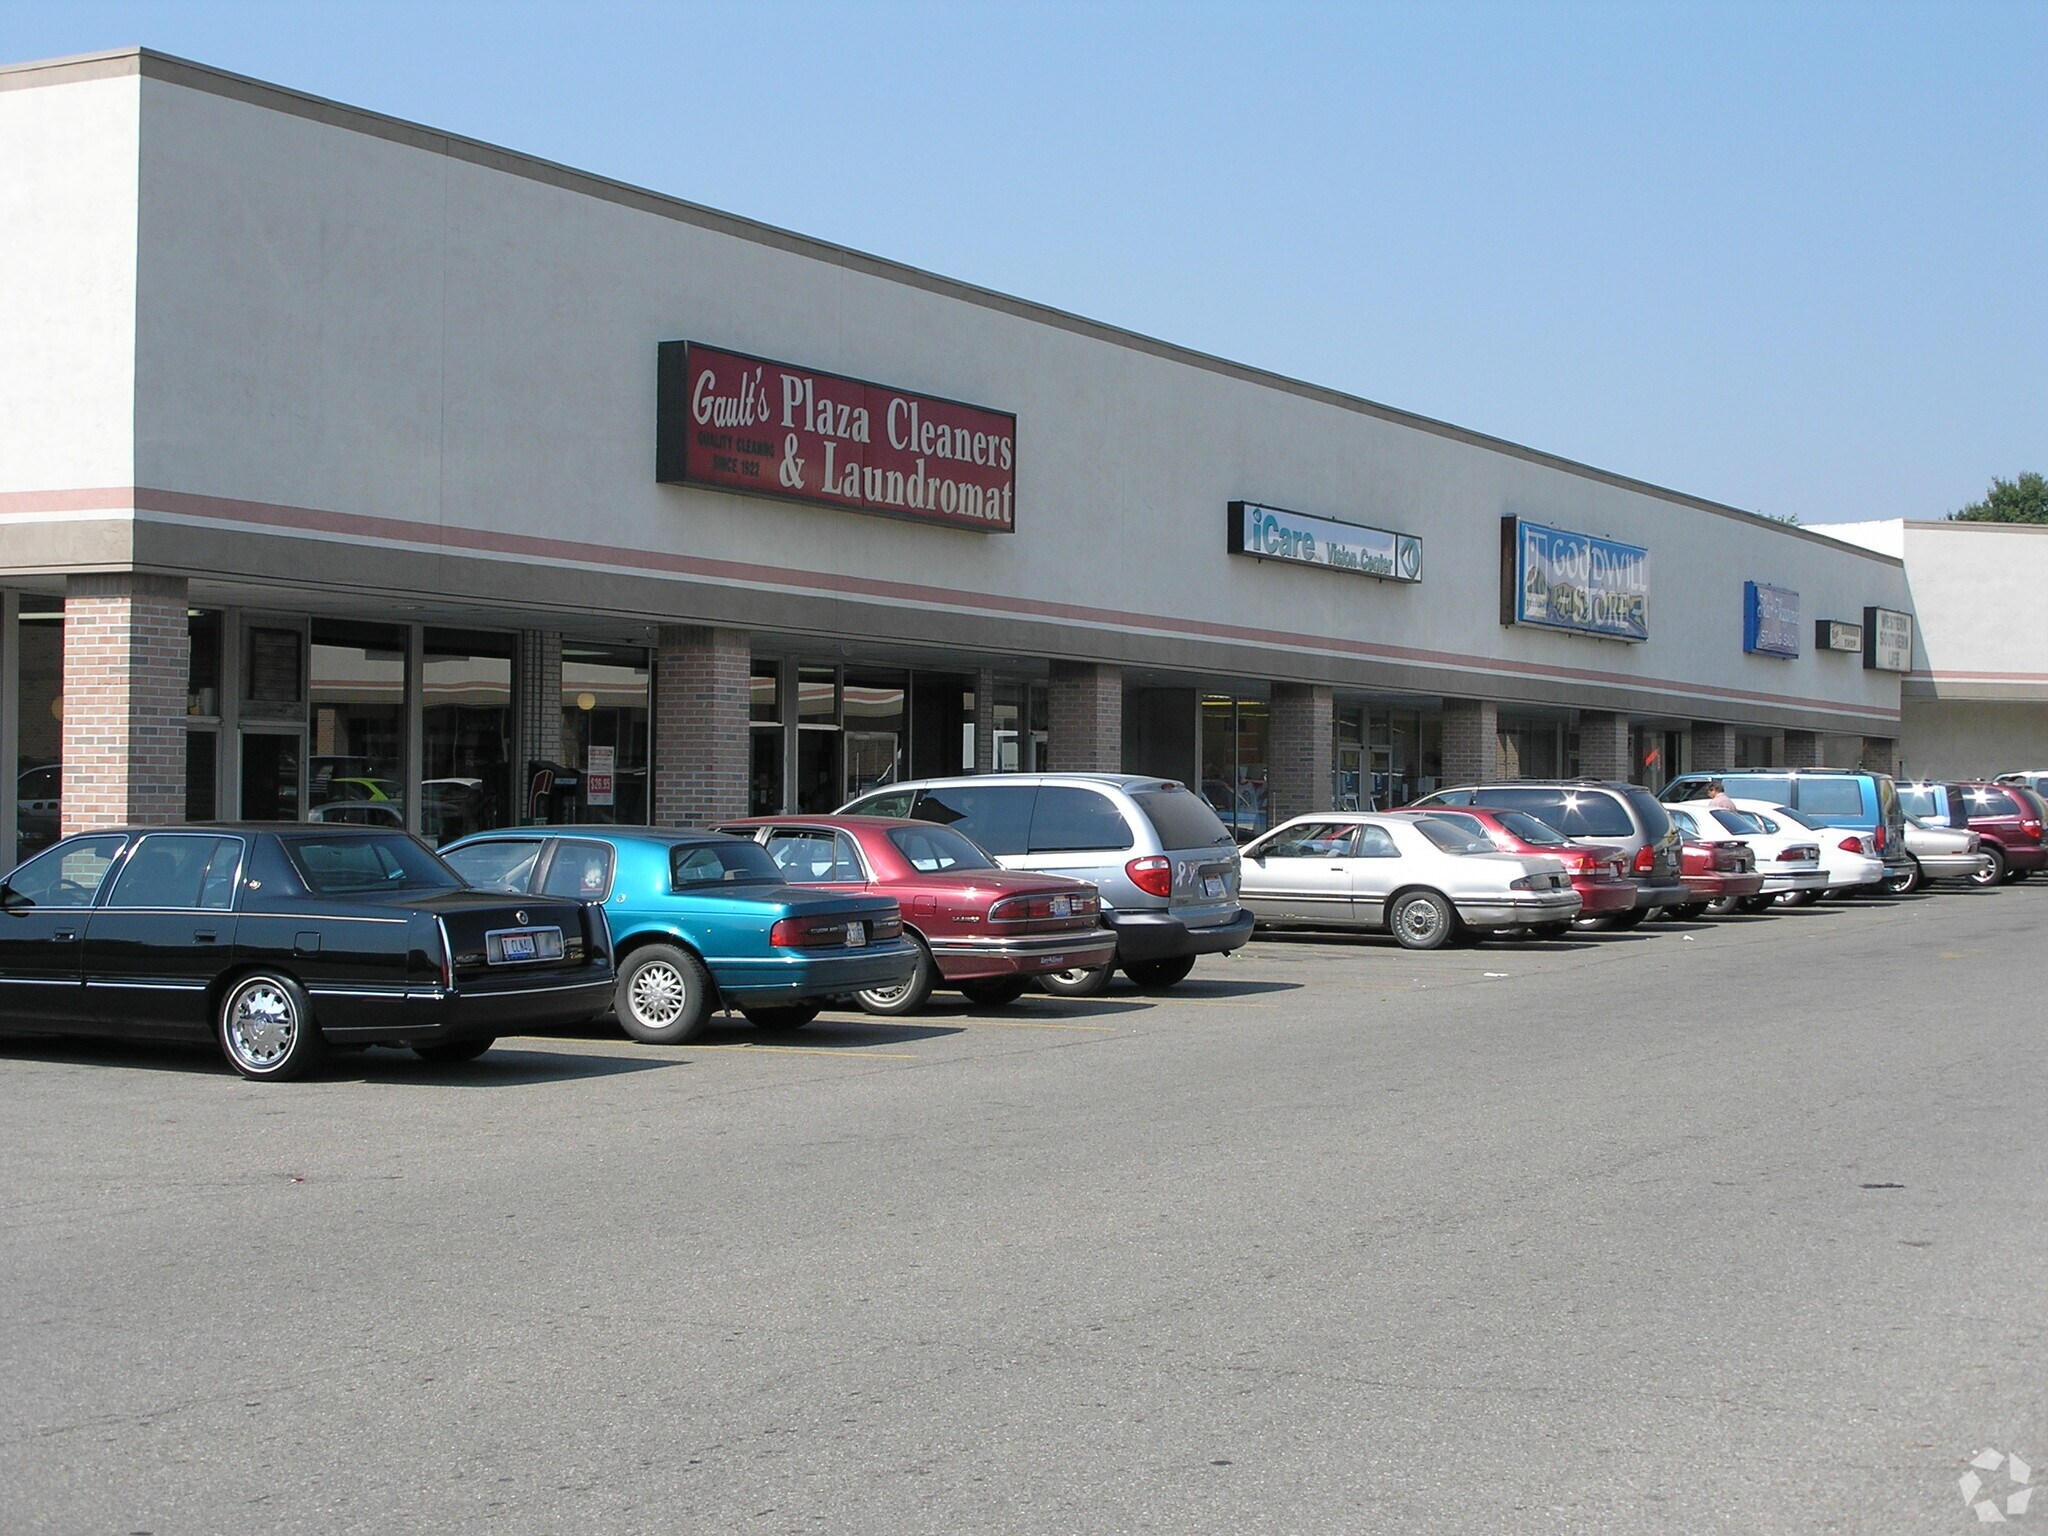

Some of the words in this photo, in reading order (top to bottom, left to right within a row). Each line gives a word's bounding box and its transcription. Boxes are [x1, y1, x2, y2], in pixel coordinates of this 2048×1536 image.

[692, 367, 770, 428] Gault's
[780, 374, 871, 444] Plaza
[887, 397, 1012, 471] Cleaners
[697, 431, 733, 451] QUALITY
[736, 438, 775, 458] CLEANING
[713, 455, 737, 473] SINCE
[779, 433, 805, 489] &
[822, 441, 1012, 523] Laundromat
[1252, 507, 1315, 560] iCare
[1326, 542, 1357, 568] Vision
[1360, 548, 1393, 575] Center
[1552, 538, 1648, 592] GOODWILL
[1572, 584, 1630, 629] STORE
